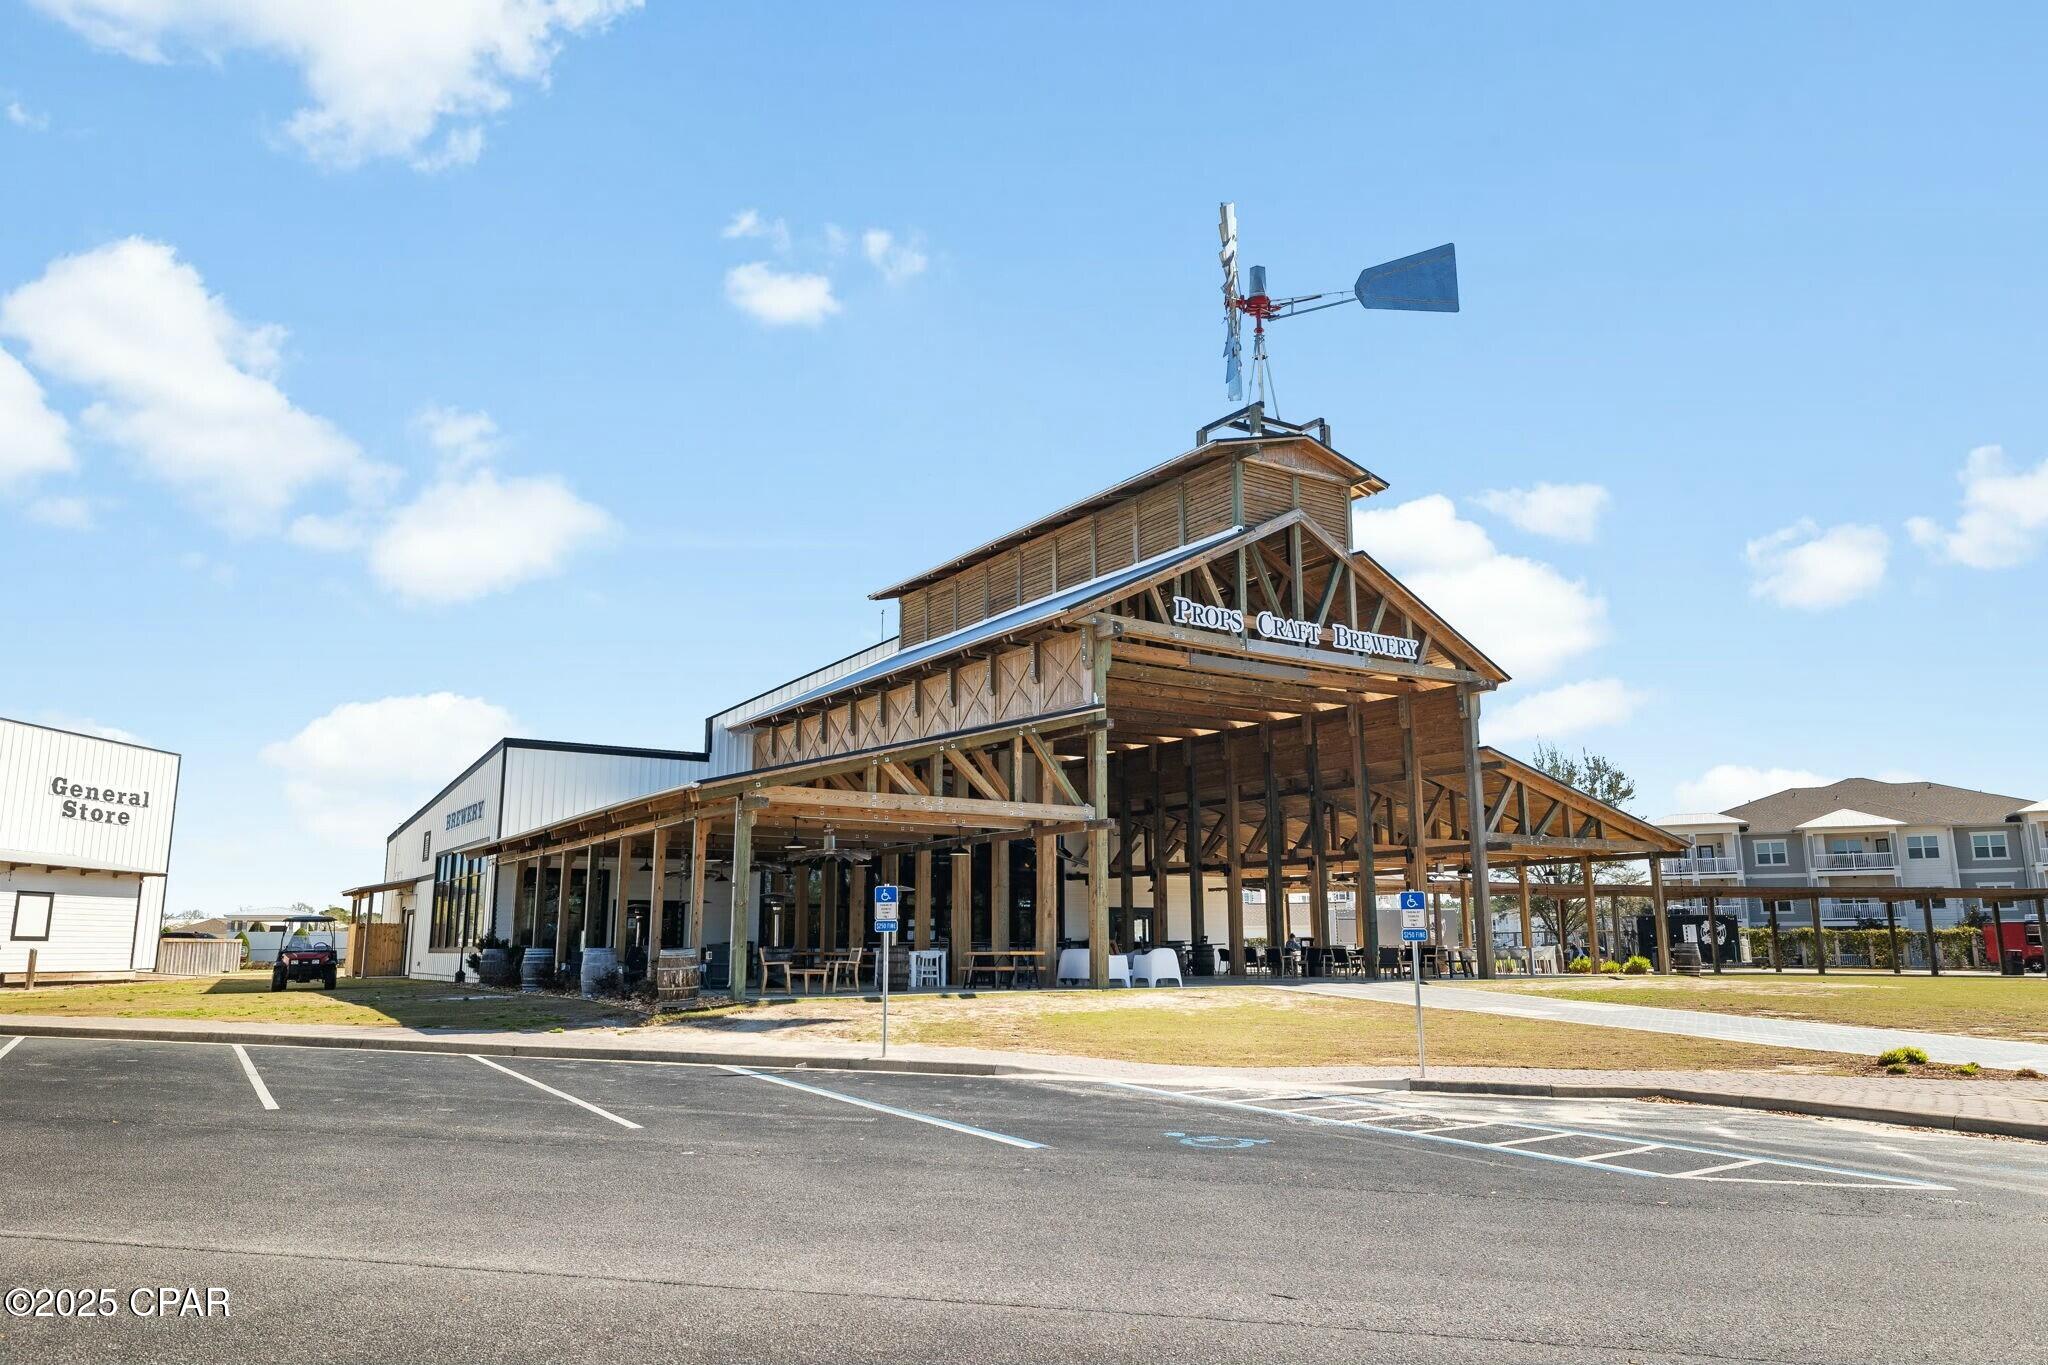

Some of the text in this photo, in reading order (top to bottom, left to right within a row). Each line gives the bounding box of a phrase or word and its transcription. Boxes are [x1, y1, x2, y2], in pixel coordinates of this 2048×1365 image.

[51, 776, 150, 808] General
[61, 799, 131, 825] Store
[445, 799, 485, 831] BREWERY
[1403, 931, 1426, 939] $250 FINE
